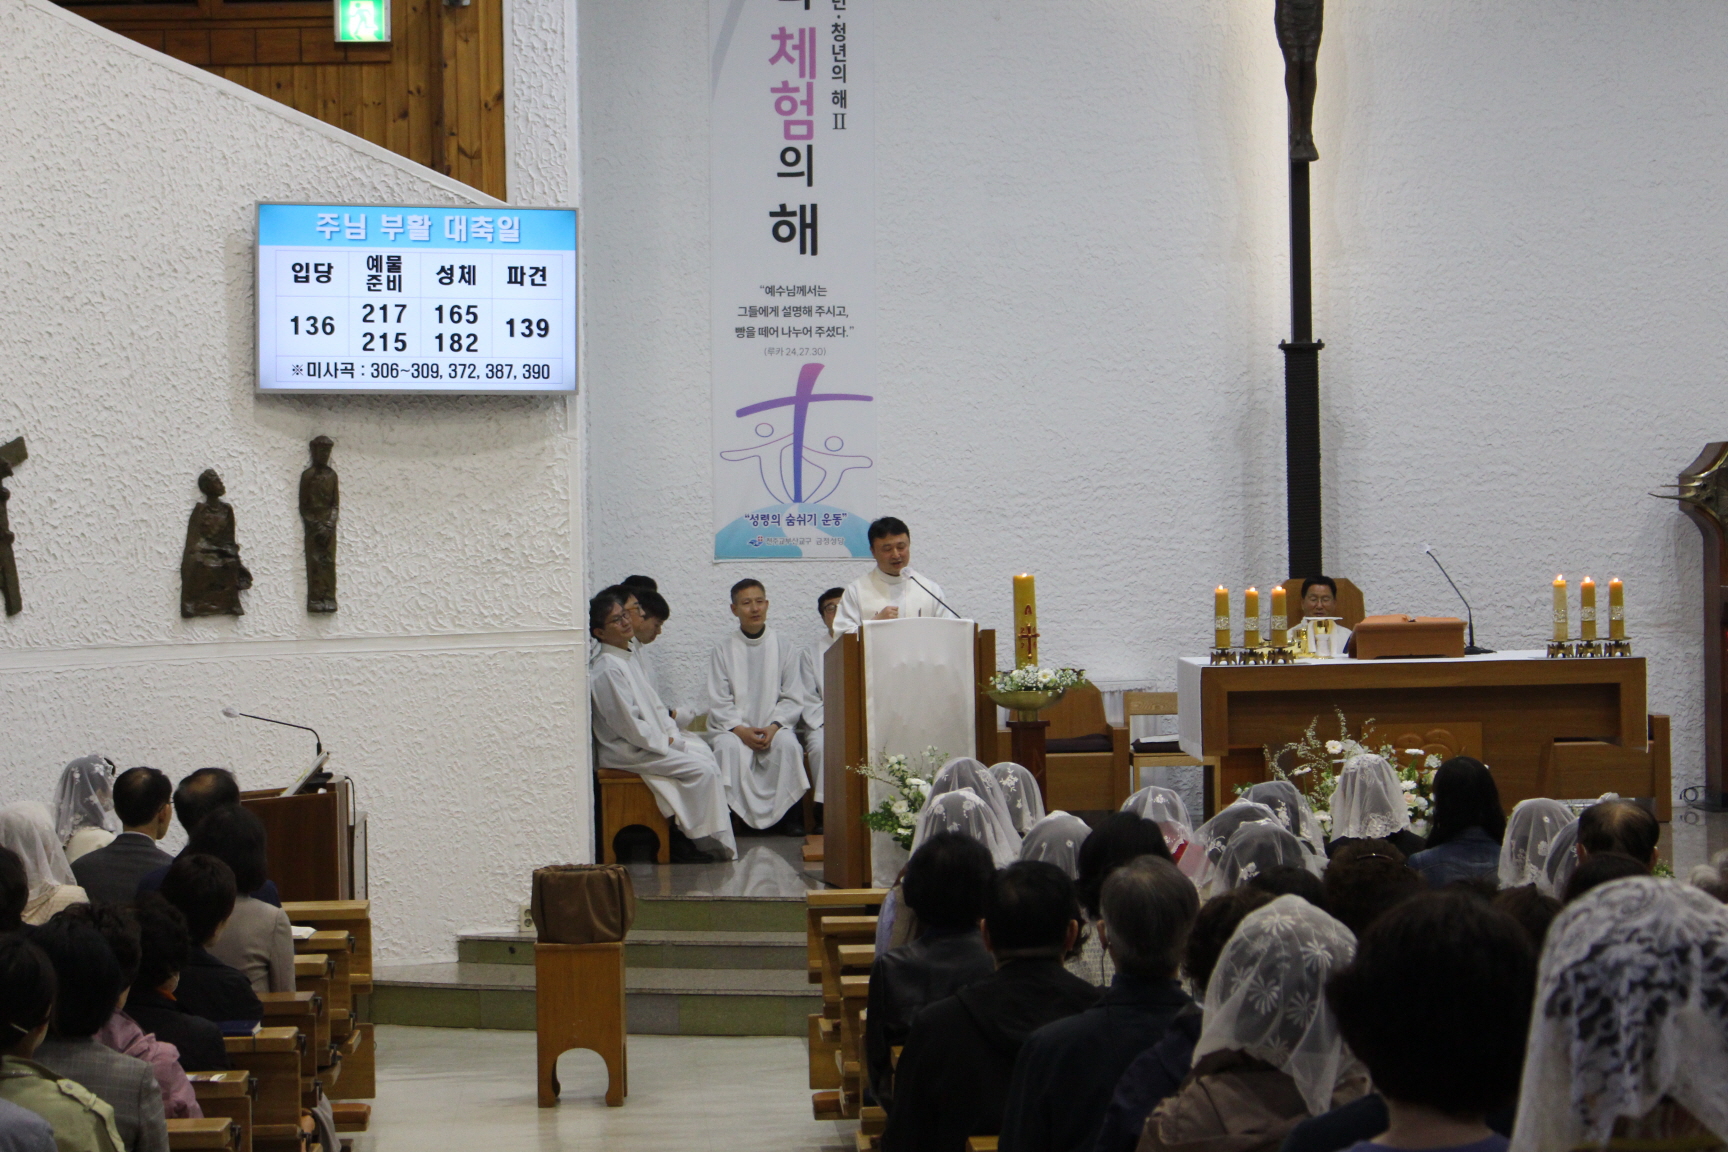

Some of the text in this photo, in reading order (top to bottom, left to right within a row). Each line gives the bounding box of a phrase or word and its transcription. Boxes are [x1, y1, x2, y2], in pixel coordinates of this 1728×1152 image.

[768, 26, 817, 188] 체험의
[831, 89, 847, 109] 해
[315, 213, 521, 243] 주님 부활 대축일
[768, 203, 818, 256] 해
[291, 262, 334, 284] 입당
[366, 254, 403, 273] 예물
[366, 274, 403, 292] 준비
[435, 264, 477, 286] 성체
[506, 265, 547, 287] 파견
[362, 303, 407, 324] 217
[434, 304, 479, 324] 165
[737, 305, 849, 319] 그들에게 설명해 주시고,
[290, 315, 335, 336] 136
[505, 318, 550, 338] 139
[734, 326, 756, 339] 빵을
[758, 326, 779, 338] 떼어
[781, 326, 813, 338] 나누어
[362, 332, 407, 352] 215
[434, 333, 479, 353] 182
[448, 363, 480, 380] 372,
[485, 363, 517, 380] 387,
[522, 363, 551, 380] 390
[785, 513, 817, 526] 숨쉬기
